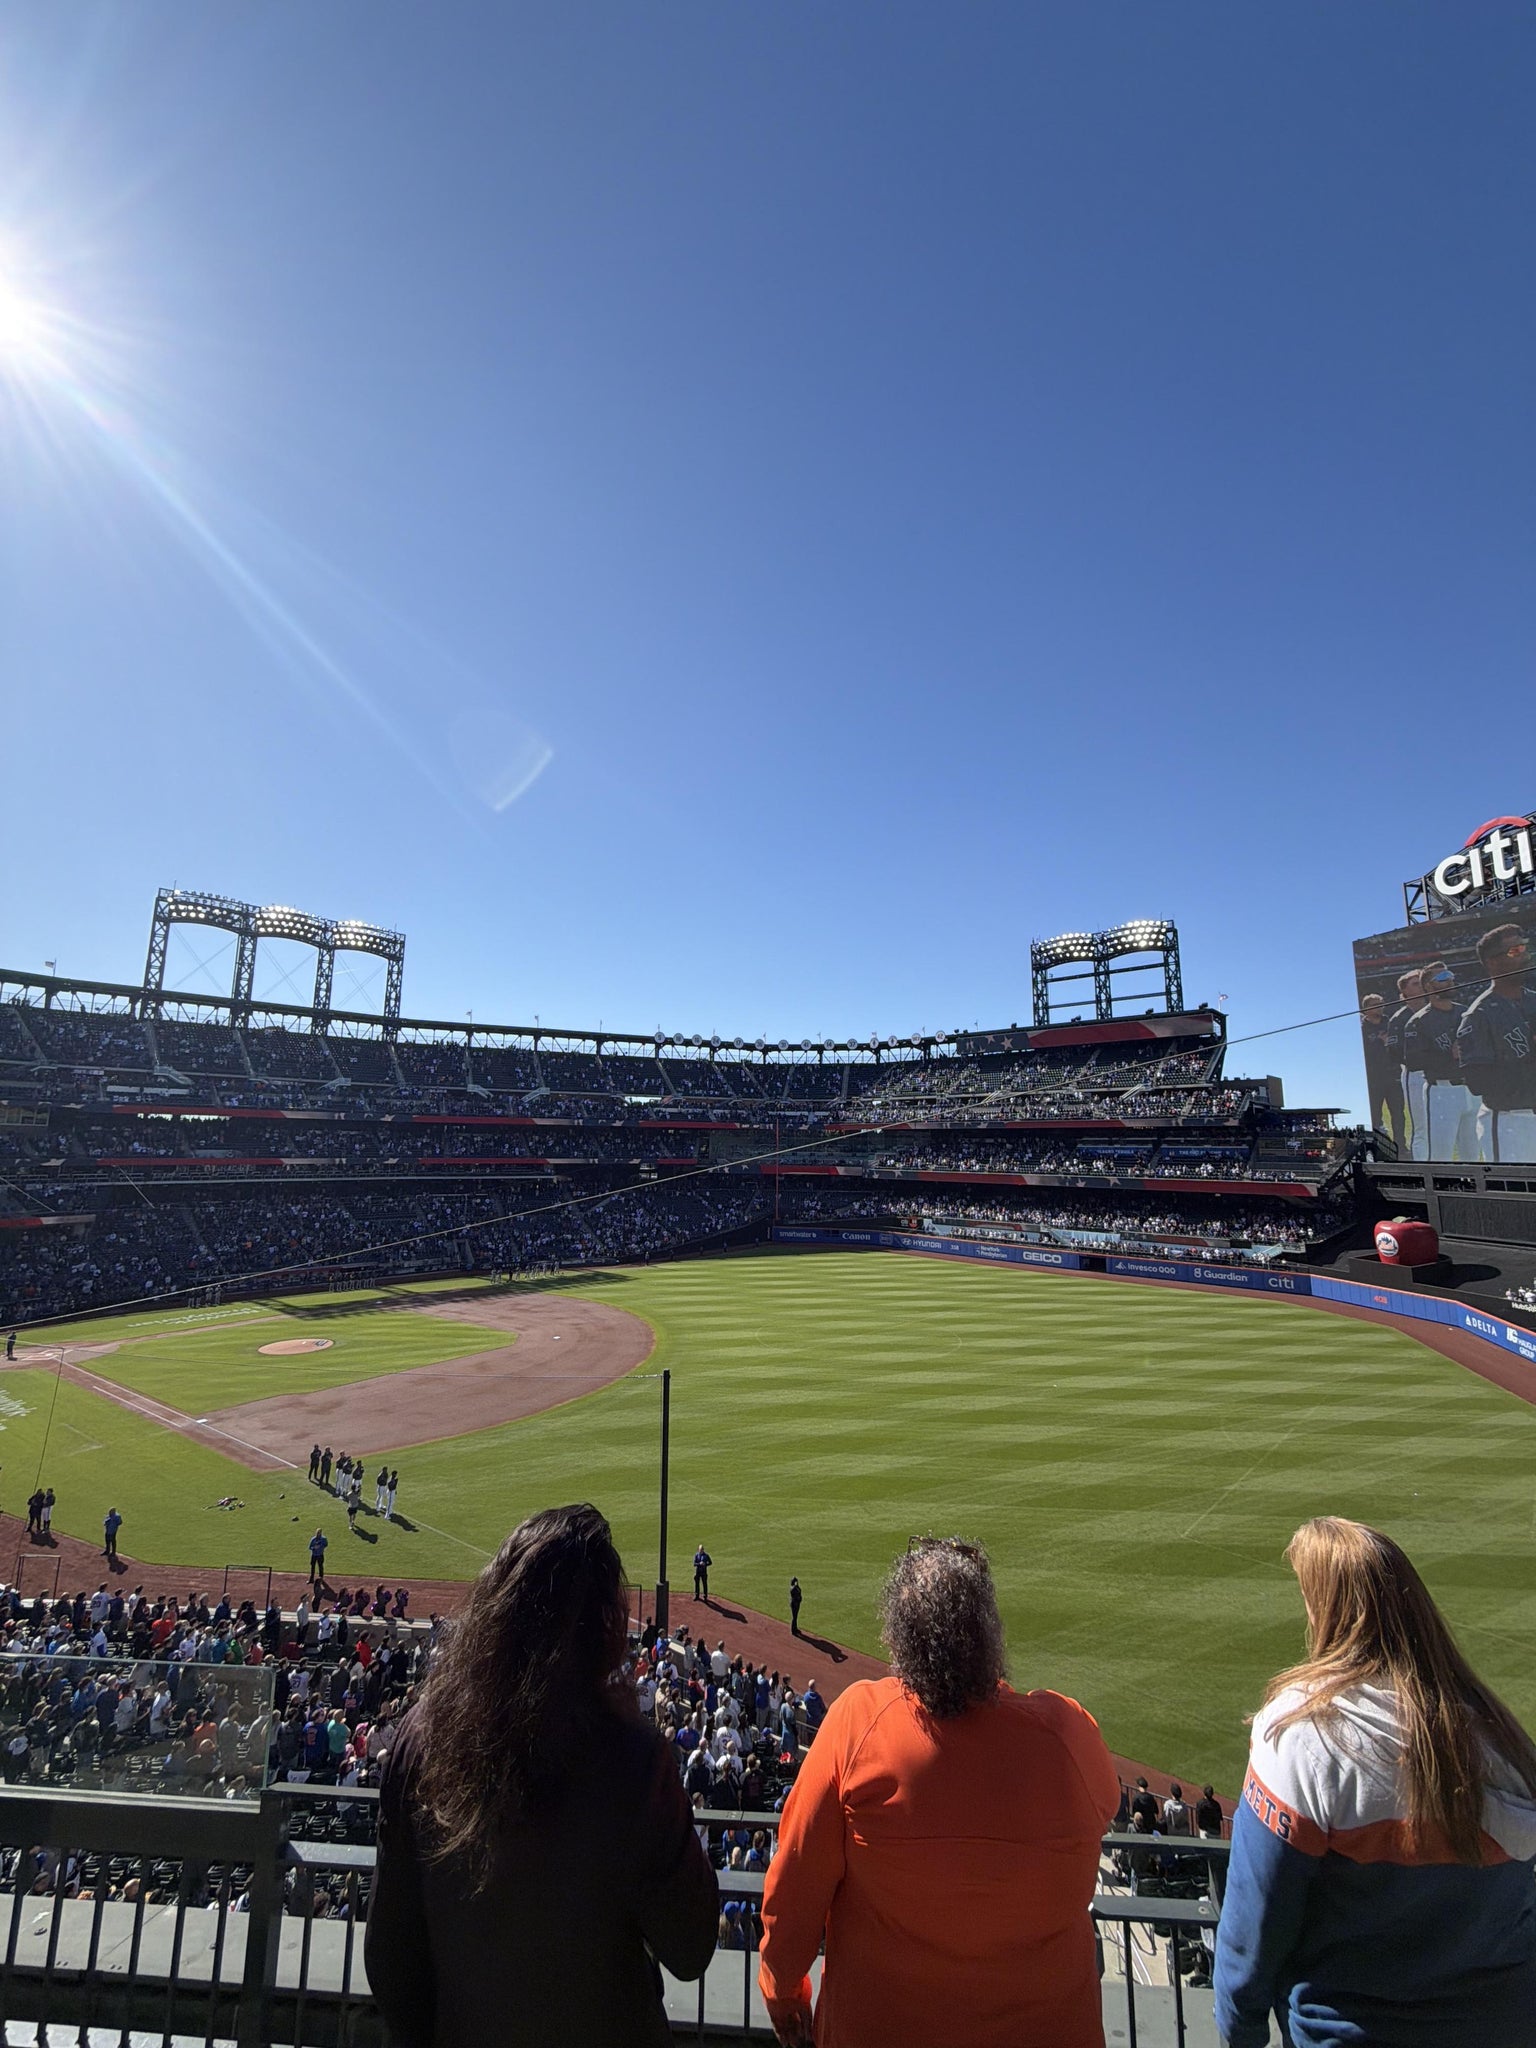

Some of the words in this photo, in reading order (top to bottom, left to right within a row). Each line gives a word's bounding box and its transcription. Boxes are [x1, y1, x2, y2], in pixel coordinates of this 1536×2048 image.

[1434, 829, 1534, 896] citi
[842, 1232, 871, 1240] Canon
[912, 1239, 942, 1249] HYUNDAI
[1023, 1251, 1062, 1264] GEICO
[1127, 1263, 1158, 1273] Invesco
[1158, 1266, 1176, 1275] QQQ
[1203, 1270, 1248, 1282] Guardian
[1268, 1277, 1295, 1289] citi
[1471, 1317, 1498, 1337] DELTA
[1244, 1778, 1293, 1841] METS
